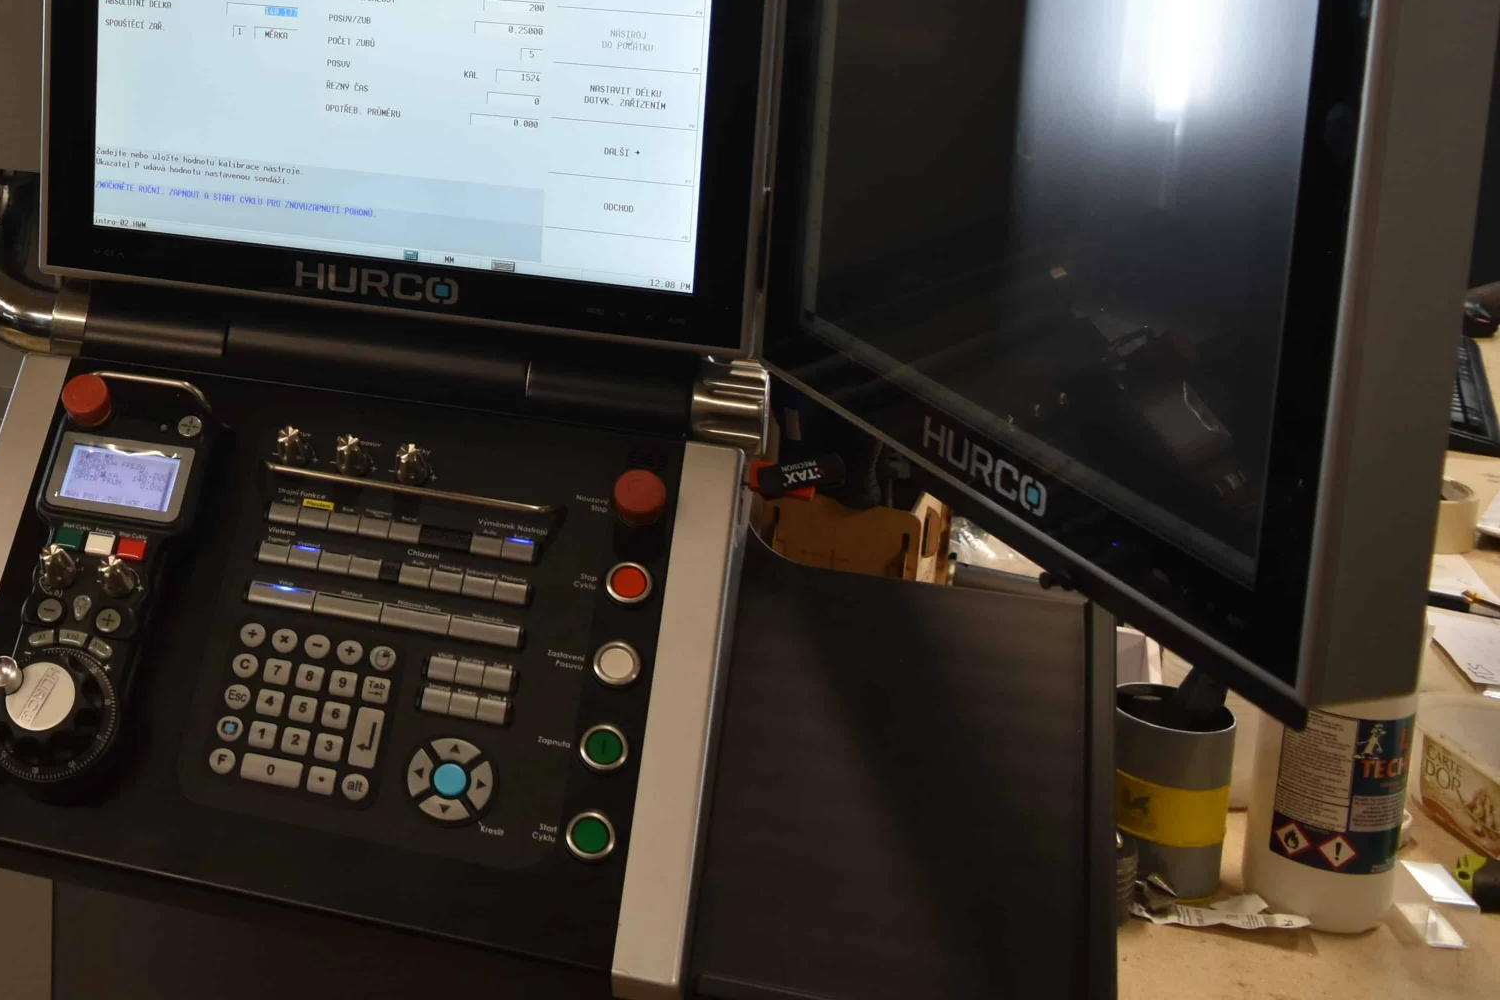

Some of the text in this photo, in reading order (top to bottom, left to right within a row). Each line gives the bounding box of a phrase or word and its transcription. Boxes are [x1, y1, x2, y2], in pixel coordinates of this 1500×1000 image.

[149, 0, 172, 9] DÉLKA
[529, 4, 545, 13] 200
[104, 18, 166, 31] SPOUŠTĚCÍ ZAŘ.
[328, 13, 372, 25] POSUV/ZUB
[264, 29, 288, 39] MĚRKA
[508, 25, 544, 36] 0.25000
[327, 35, 375, 48] POČET ZUBŮ
[601, 40, 613, 49] DO
[529, 50, 535, 59] 5
[326, 59, 351, 69] POSUV
[463, 70, 479, 80] KAL
[520, 73, 541, 82] 1524
[326, 80, 369, 93] ŘEZNÝ ČAS
[589, 84, 662, 98] NASTAVIT DÉLKU
[534, 98, 540, 106] 0
[583, 96, 667, 110] DOTYK. ZAŘÍZENÍM
[325, 103, 401, 118] OPOTŘEB. PRŮMĚRU
[513, 119, 539, 129] 0.000
[603, 146, 630, 158] DALŠÍ
[95, 147, 304, 176] Zadejte nebo uložte hodnotu kalibrace nástroje.
[95, 157, 290, 185] Ukazatel P udává hodnotu nastavenou sondáží.
[169, 188, 200, 200] ZAPNOUT
[213, 192, 236, 203] START
[239, 195, 263, 206] CYKLU
[266, 198, 281, 208] PRO
[285, 200, 341, 214] ZNOVUZAPNUTÍ
[344, 206, 377, 218] POHONŮ.
[603, 202, 635, 214] ODCHOD
[444, 255, 455, 264] MM
[295, 259, 459, 305] HURCO
[649, 278, 691, 291] 12:08 PM
[781, 460, 817, 473] PRECISION
[923, 415, 1047, 518] HURCO
[575, 492, 610, 506] Nouzový
[590, 502, 608, 514] Stop
[406, 548, 441, 560] Chlazení
[580, 572, 598, 583] Stop
[573, 579, 597, 591] Cyklu
[547, 649, 586, 663] Zastavení
[240, 658, 250, 670] C
[555, 659, 584, 671] Posuvu
[273, 665, 282, 676] 7
[305, 670, 314, 682] 8
[338, 676, 347, 688] 9
[368, 680, 386, 691] Tab
[227, 689, 248, 703] Esc
[265, 695, 274, 707] 4
[298, 702, 308, 714] 5
[331, 708, 341, 720] 6
[258, 728, 266, 739] 1
[291, 734, 301, 746] 2
[324, 740, 333, 752] 3
[217, 753, 227, 766] F
[1426, 744, 1465, 778] CARTE
[266, 764, 276, 776] 0
[1425, 758, 1461, 791] D'OR
[346, 779, 364, 793] alt
[479, 824, 505, 837] Kreslit
[539, 822, 558, 833] Start
[532, 831, 556, 843] Cyklu
